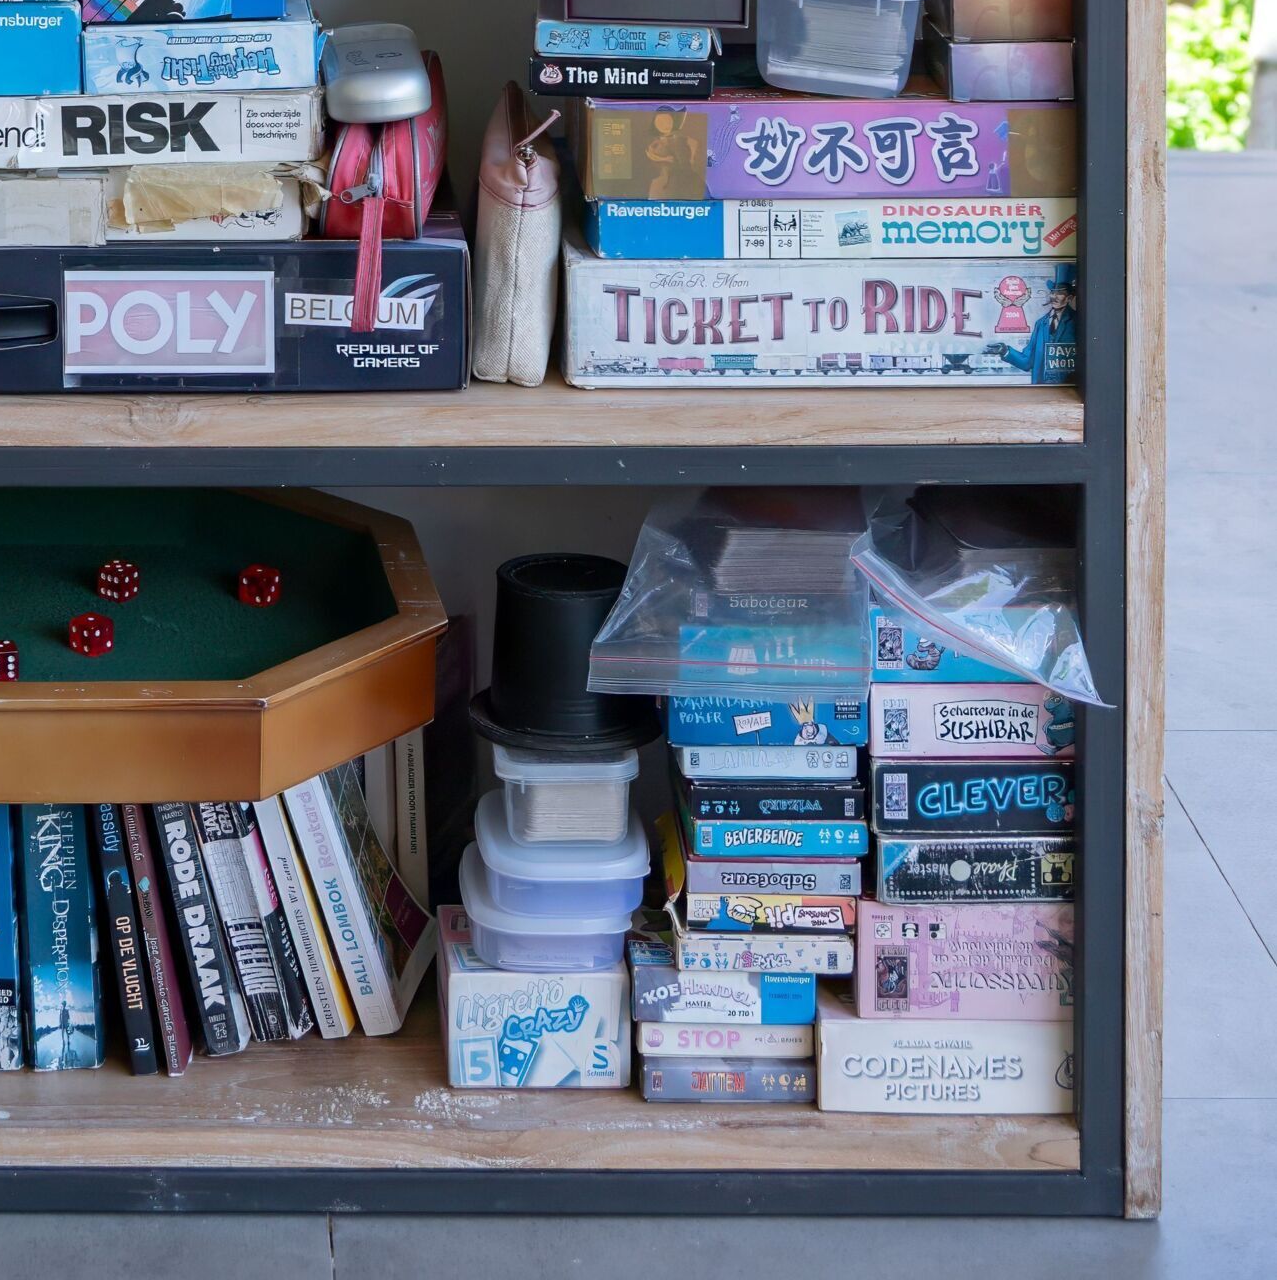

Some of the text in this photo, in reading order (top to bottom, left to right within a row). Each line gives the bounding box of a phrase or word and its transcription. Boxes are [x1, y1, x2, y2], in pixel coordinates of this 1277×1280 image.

[233, 46, 281, 76] Hey
[566, 65, 599, 85] The
[604, 67, 649, 85] Mind
[61, 100, 221, 157] RISK
[737, 113, 980, 185] 妙不可言
[606, 203, 712, 220] Ravensburger
[882, 200, 1043, 217] DINOSAURIËR
[882, 220, 1046, 255] memory
[713, 272, 750, 289] Moon
[66, 288, 259, 356] POLY
[603, 277, 984, 346] TICKET TO RIDE
[336, 344, 440, 355] REPUBLIC OF
[353, 357, 421, 369] GAMERS
[729, 595, 810, 609] Saboteur
[1009, 705, 1019, 718] in
[1021, 706, 1034, 719] de
[939, 719, 1034, 741] SUSHIBAR
[917, 775, 1066, 817] CLEVER
[35, 808, 64, 894] KING
[60, 810, 78, 891] STEPHEN
[724, 827, 804, 848] BEVERBENDE
[721, 872, 817, 891] Saboteur
[907, 862, 949, 876] Master
[163, 819, 226, 1010] RODE DRAAK
[322, 876, 360, 952] LOMBOK
[115, 915, 144, 1012] OP DE VLUCHT
[236, 949, 279, 995] RIVER
[350, 954, 375, 997] BALI,
[313, 975, 337, 1029] KRISTIEN
[456, 977, 565, 1034] Ligretto
[502, 996, 591, 1042] CRAZY
[677, 1029, 742, 1049] STOP
[468, 1048, 492, 1083] 5
[585, 1068, 615, 1079] Schmidt
[841, 1053, 1024, 1080] CODENAMES
[884, 1083, 981, 1101] PICTURES
